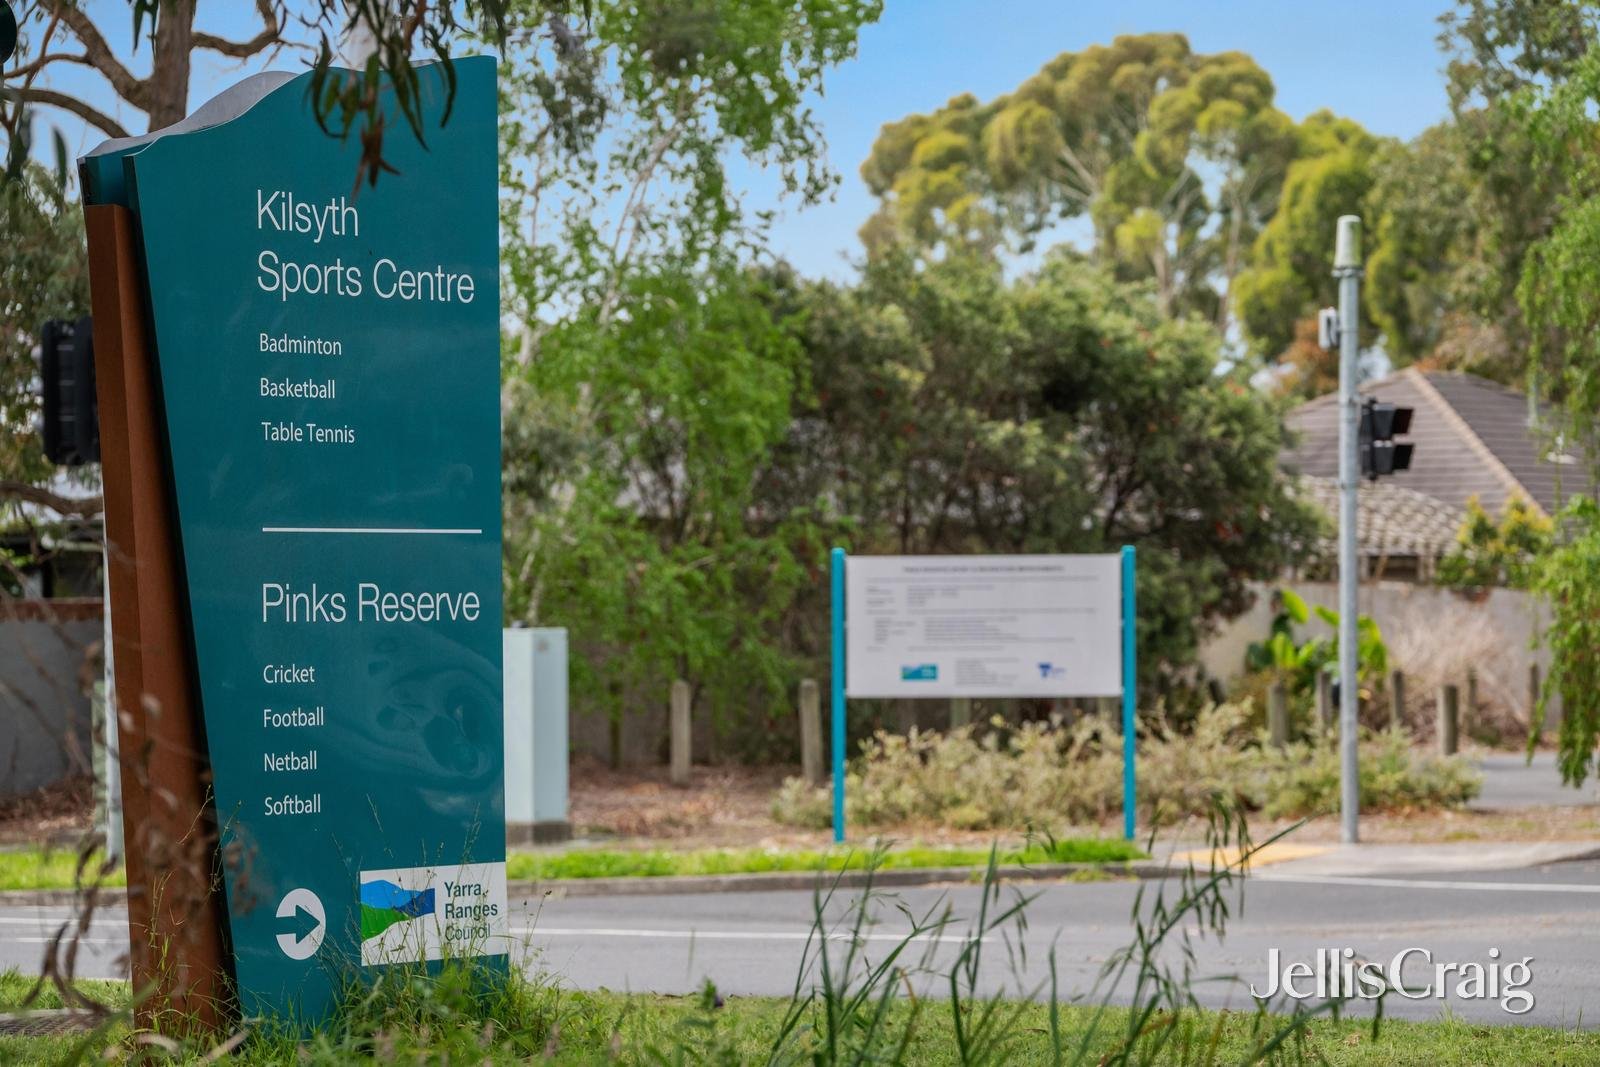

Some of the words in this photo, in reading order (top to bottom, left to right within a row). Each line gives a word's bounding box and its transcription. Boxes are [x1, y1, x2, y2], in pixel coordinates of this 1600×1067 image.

[257, 189, 359, 243] Kilsyth
[257, 250, 363, 302] Sports
[373, 258, 475, 303] Centre
[259, 333, 342, 355] Badminton
[260, 377, 336, 399] Basketball
[261, 421, 303, 442] Table
[306, 423, 355, 443] Tennis
[262, 583, 347, 623] Pinks
[358, 583, 480, 622] Reserve
[263, 664, 315, 684] Cricket
[263, 706, 324, 728] Football
[264, 750, 317, 772] Netball
[264, 793, 321, 816] Softball
[444, 881, 482, 898] Yarra
[445, 903, 498, 921] Ranges
[445, 923, 491, 942] Council
